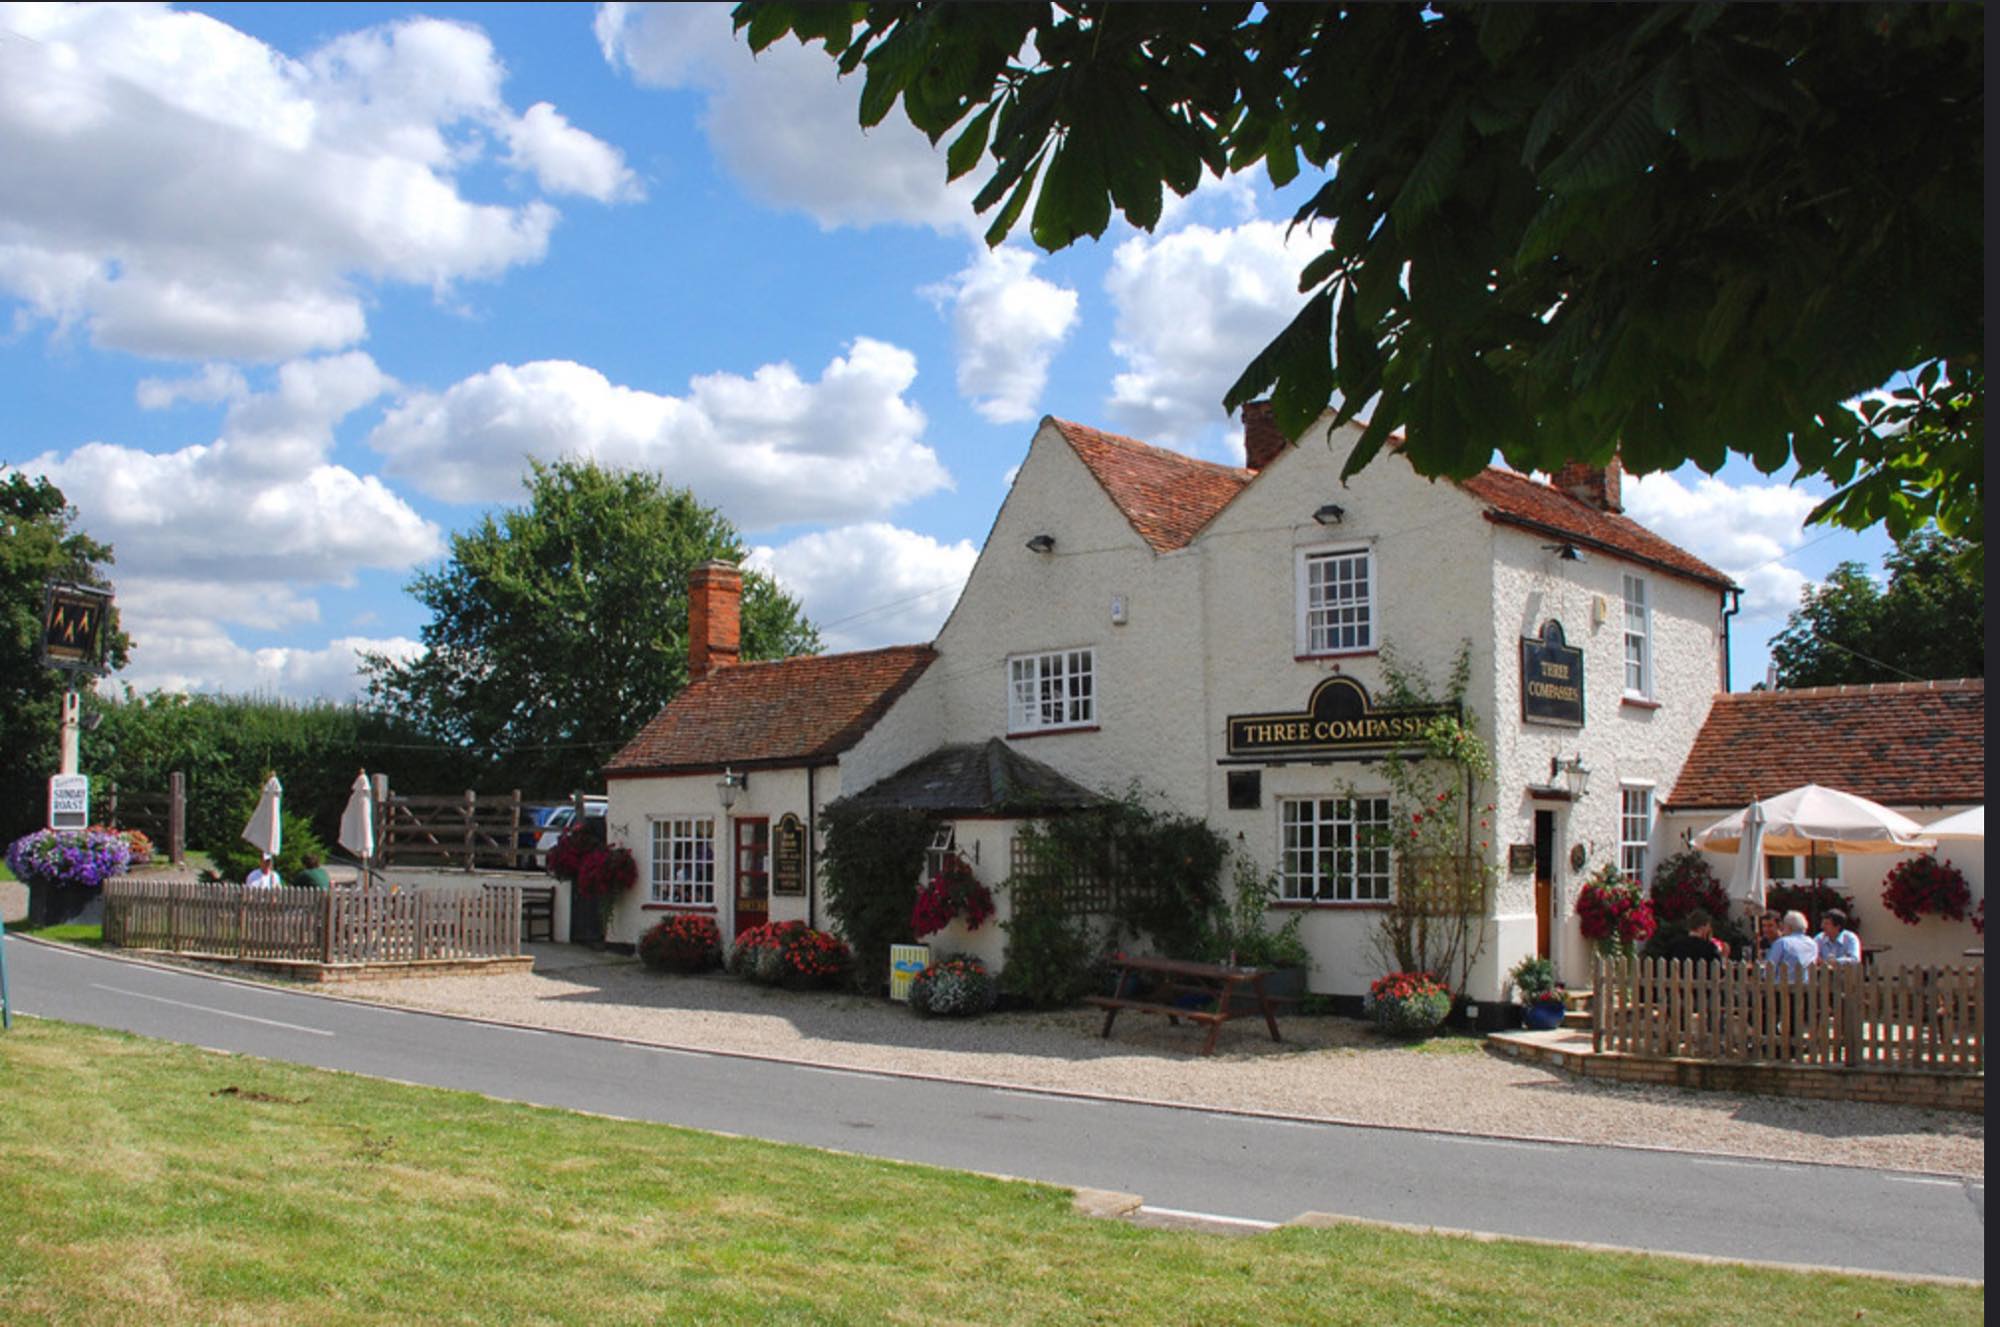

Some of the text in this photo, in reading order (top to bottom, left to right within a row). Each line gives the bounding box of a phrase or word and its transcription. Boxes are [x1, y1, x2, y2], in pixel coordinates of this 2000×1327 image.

[1540, 661, 1570, 680] THREE
[1528, 681, 1578, 702] COMPASSES
[1243, 724, 1310, 743] THREE
